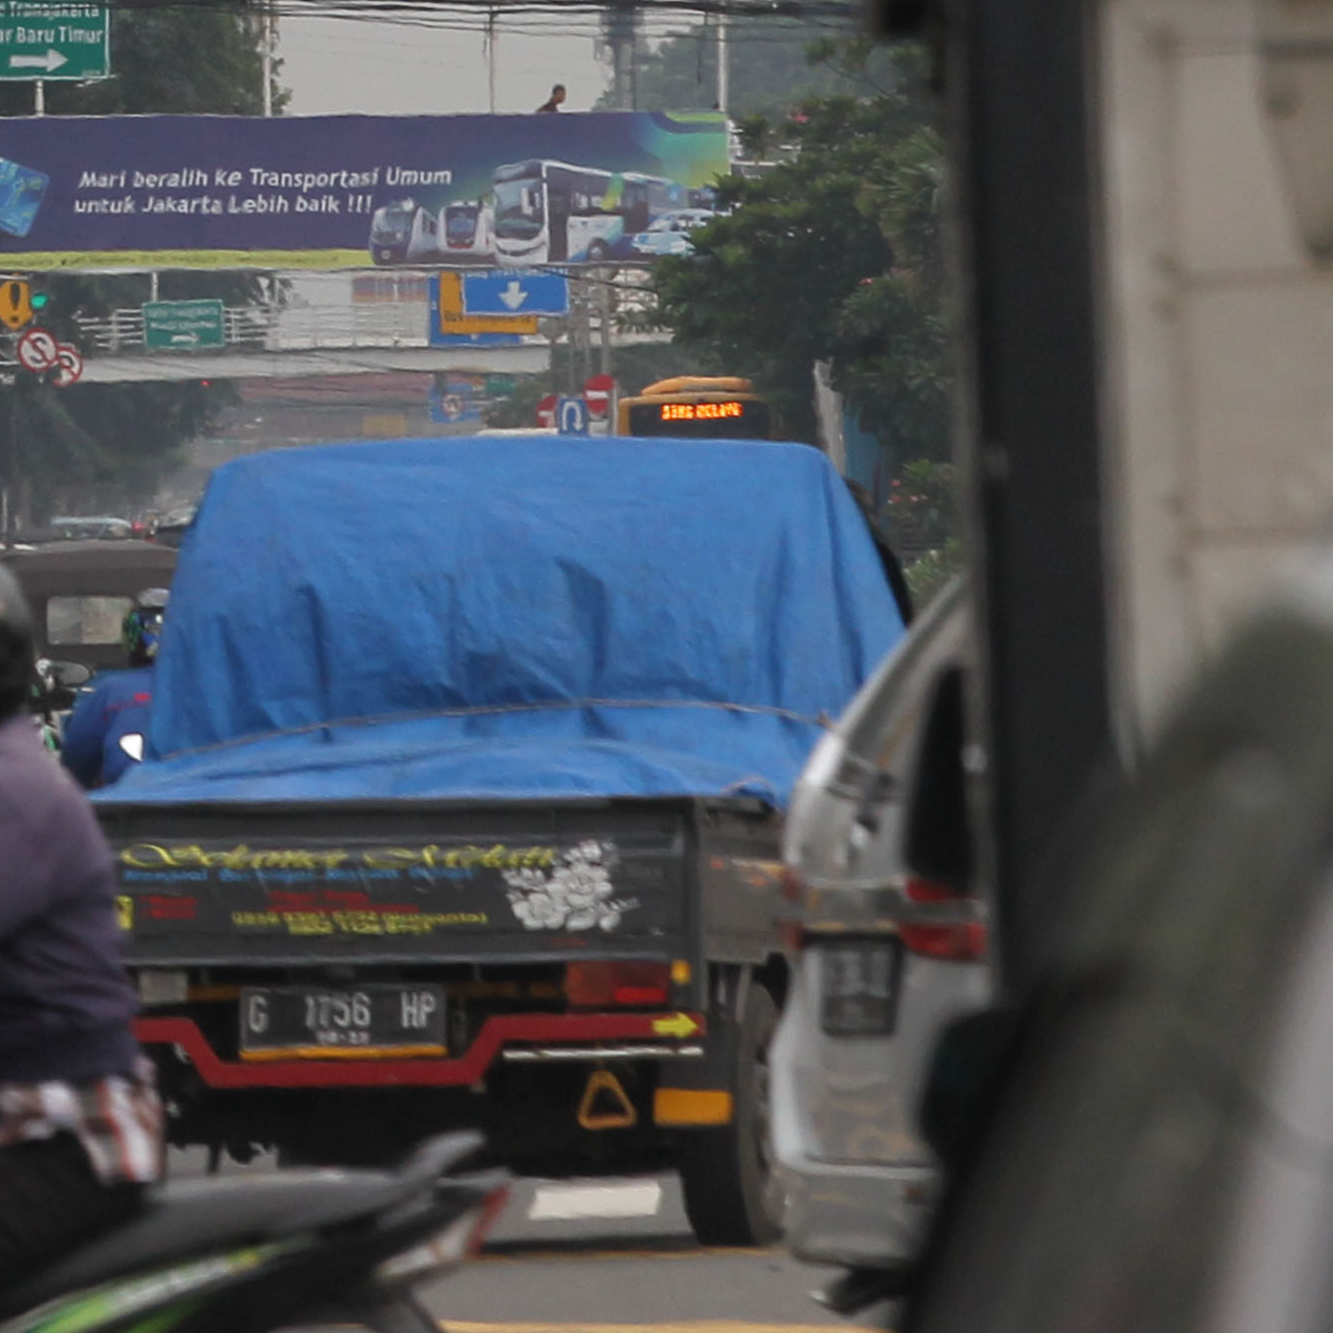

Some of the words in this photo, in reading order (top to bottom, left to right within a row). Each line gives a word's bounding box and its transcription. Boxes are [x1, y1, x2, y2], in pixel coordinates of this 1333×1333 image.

[16, 27, 55, 43] Baru
[58, 26, 103, 44] Timur
[78, 170, 125, 188] Mari
[133, 169, 208, 188] beralih
[249, 167, 378, 192] Transportasi
[386, 167, 452, 186] Umum
[74, 195, 133, 214] untuk
[141, 196, 222, 214] Jakarta
[228, 195, 289, 213] Lebih
[295, 194, 340, 213] baik
[249, 995, 269, 1033] G
[305, 992, 372, 1029] 1756
[400, 991, 435, 1028] HP
